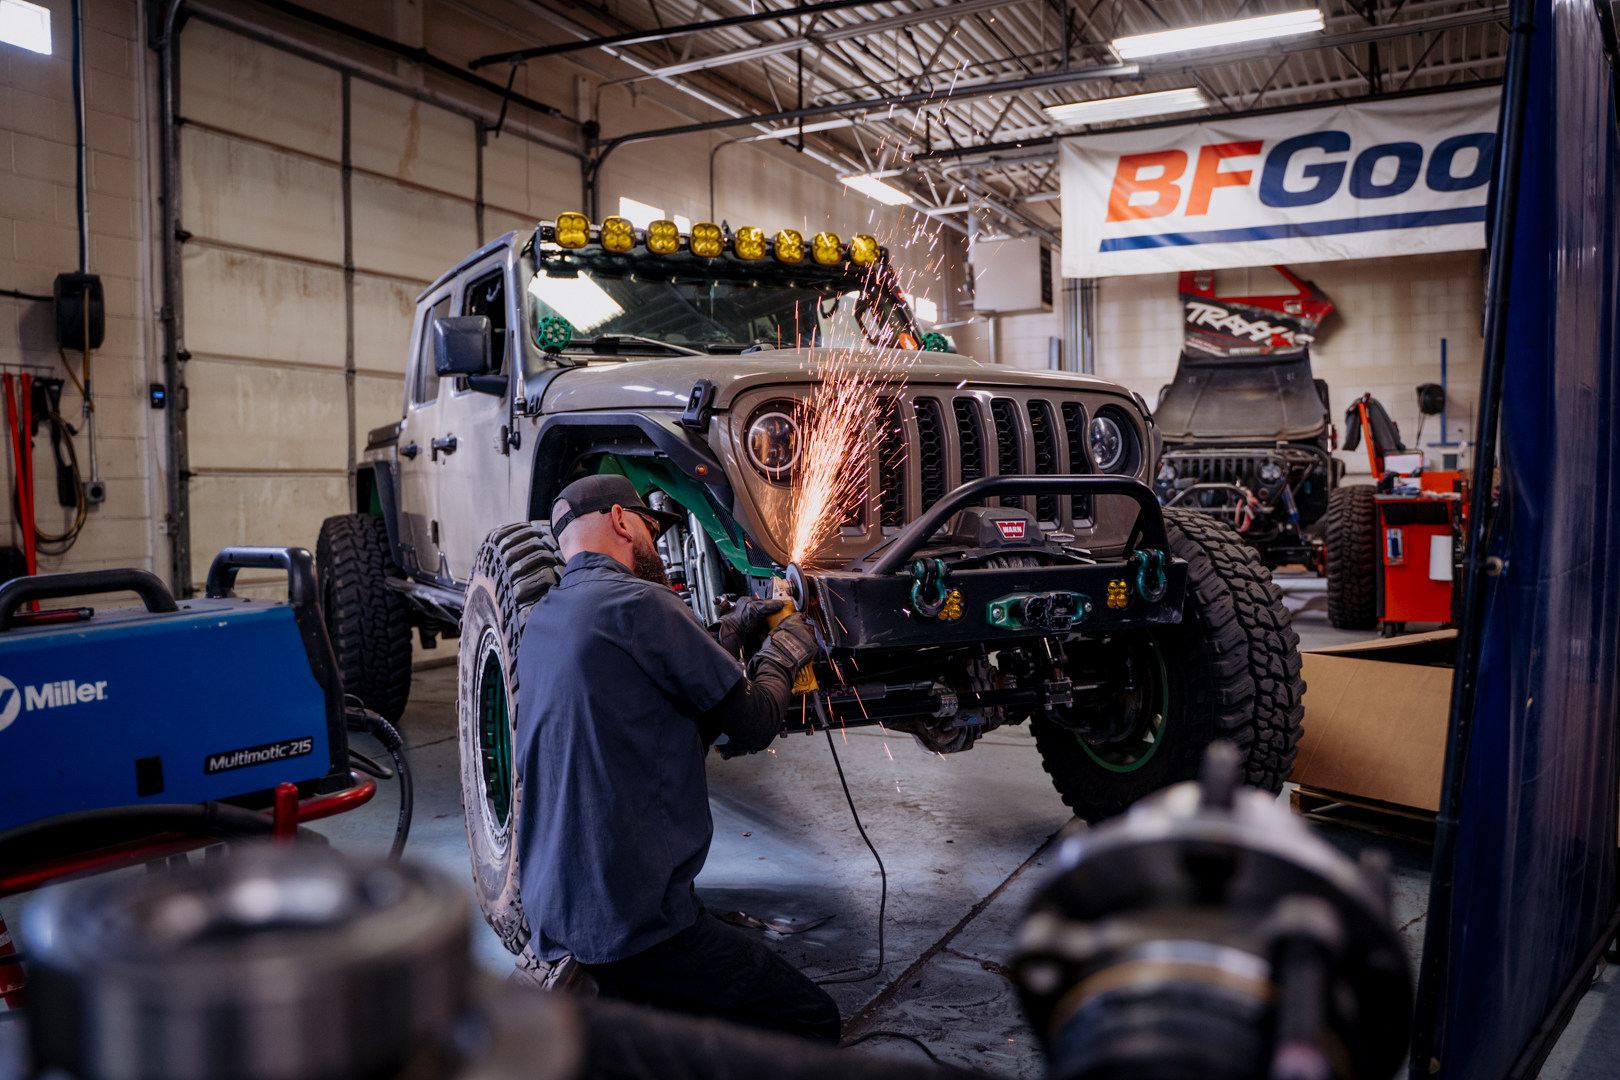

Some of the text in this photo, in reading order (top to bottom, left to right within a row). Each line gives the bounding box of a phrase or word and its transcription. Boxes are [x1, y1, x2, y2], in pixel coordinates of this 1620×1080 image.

[1105, 130, 1497, 223] BFGoo
[24, 679, 108, 711] Miller
[209, 738, 312, 771] Multimatic 215
